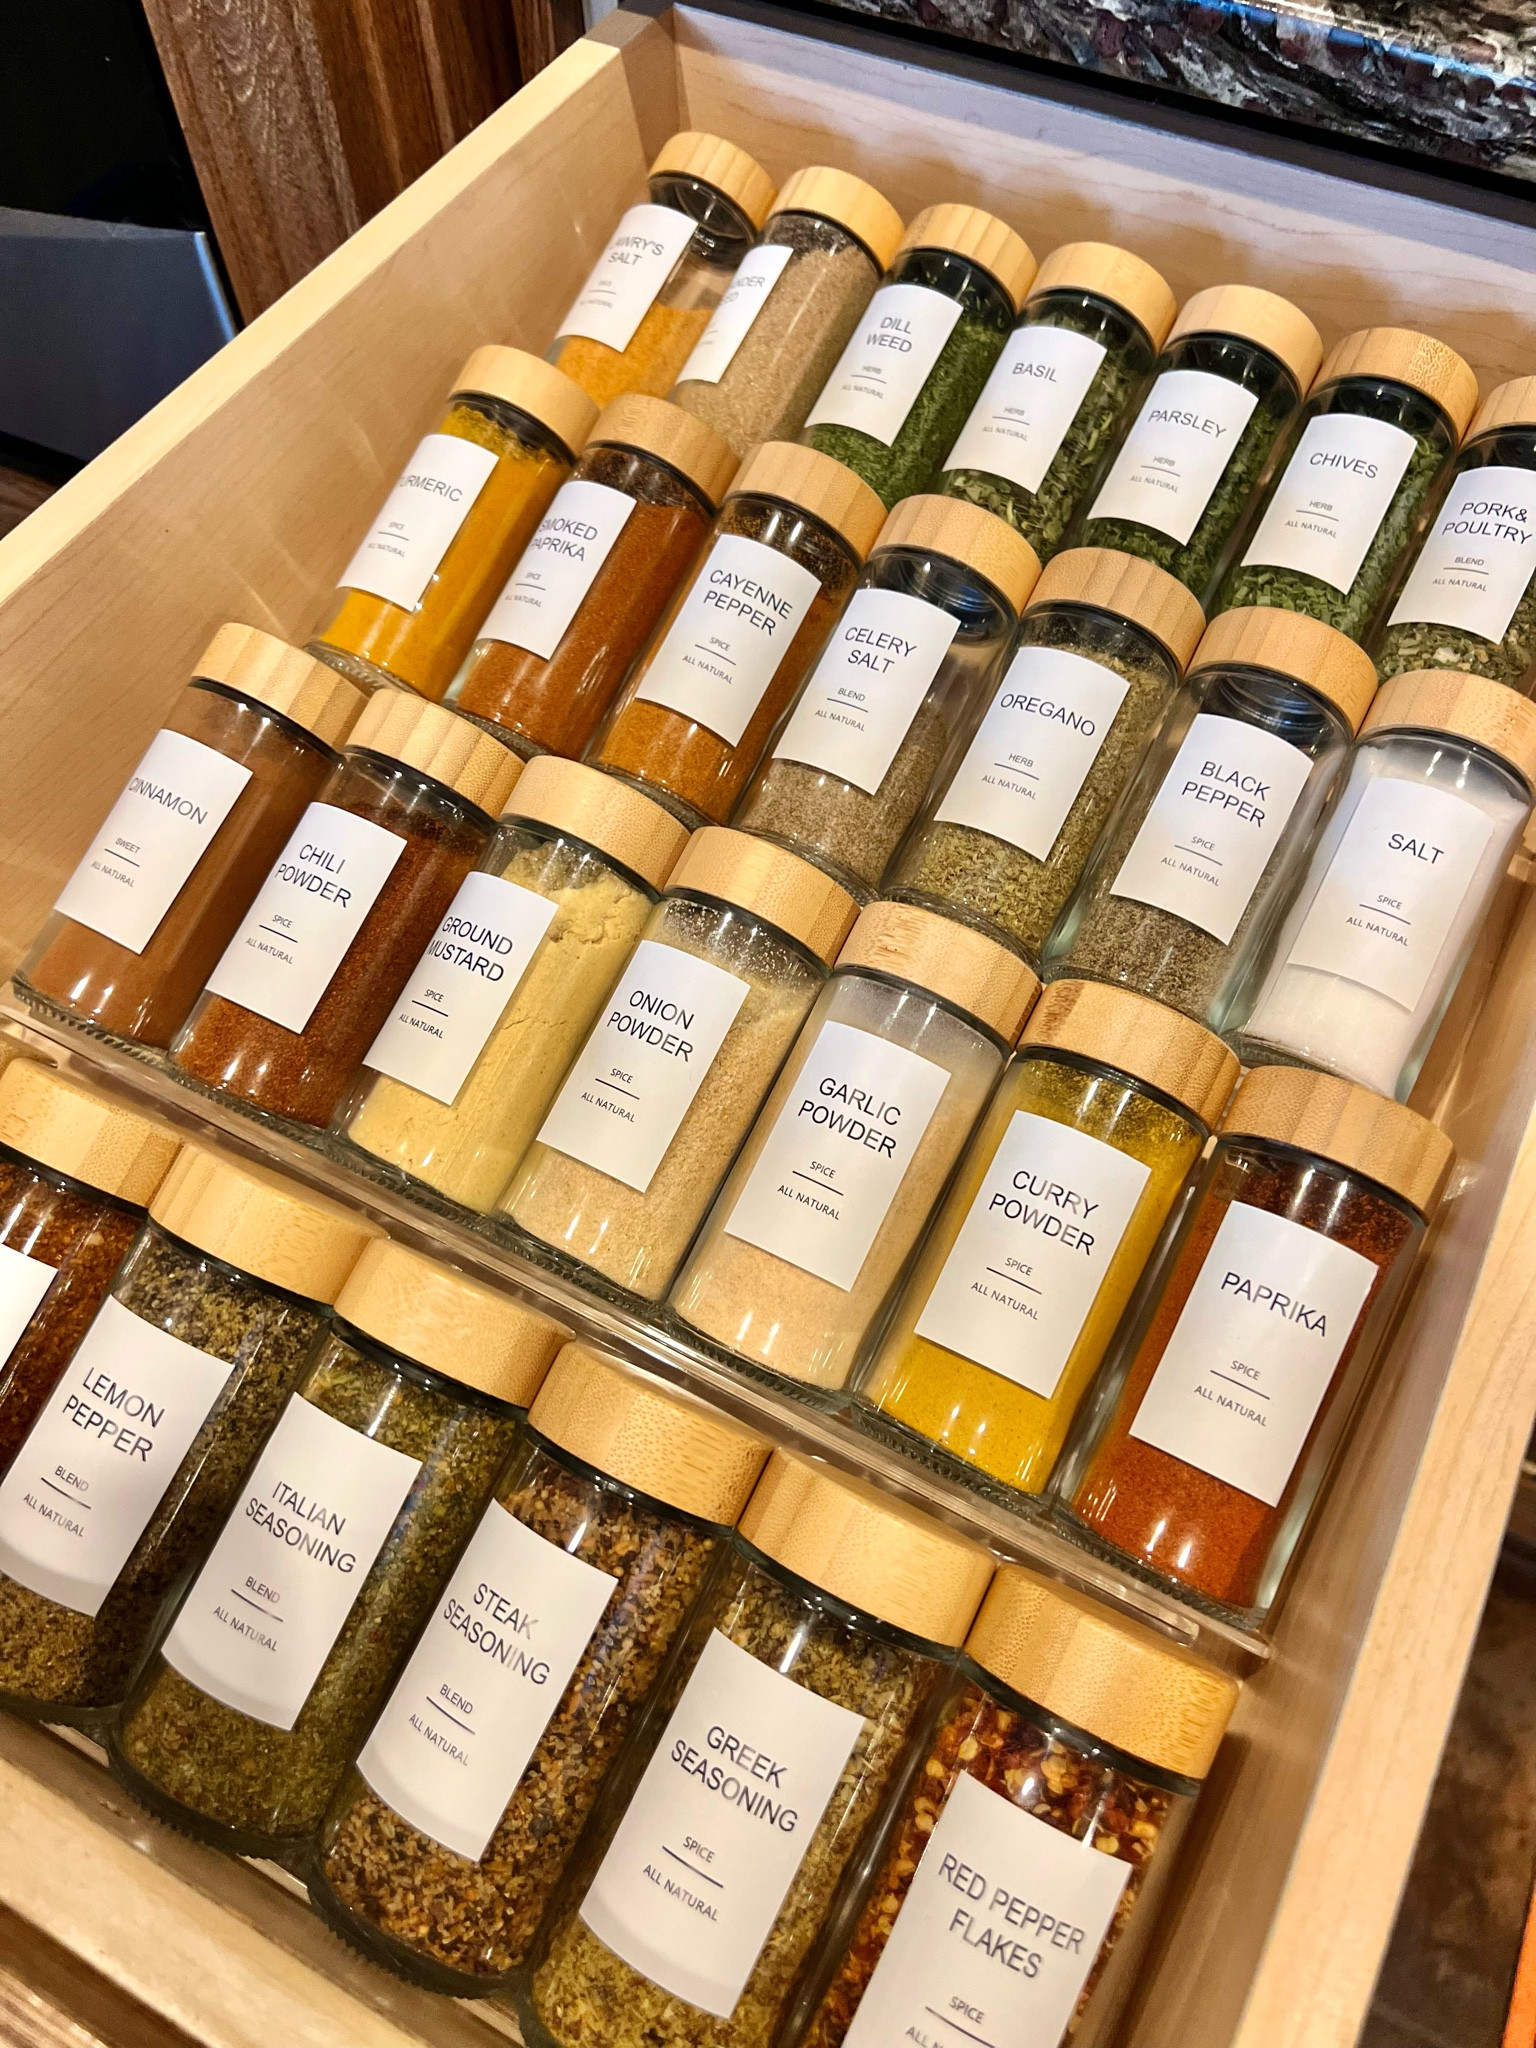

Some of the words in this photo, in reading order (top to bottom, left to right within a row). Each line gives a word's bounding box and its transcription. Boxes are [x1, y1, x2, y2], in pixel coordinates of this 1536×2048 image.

[608, 252, 642, 266] SALT
[880, 317, 912, 334] DILL
[866, 334, 912, 353] WEED
[862, 366, 882, 374] HERB
[1012, 362, 1057, 382] BASIL
[854, 386, 883, 400] NATURAL
[1004, 406, 1025, 416] HERB
[1148, 410, 1227, 438] PARSLEY
[996, 427, 1028, 442] NATURAL
[1153, 456, 1176, 467] HERB
[1310, 453, 1378, 478] CHIVES
[1144, 477, 1178, 494] NATURAL
[1310, 500, 1333, 512] HERB
[1460, 502, 1528, 524] PORK&
[388, 521, 405, 530] SPICE
[1285, 520, 1298, 528] ALL
[1301, 522, 1337, 538] NATURAL
[1442, 521, 1532, 544] POULTRY
[378, 543, 405, 558] NATURAL
[1454, 556, 1484, 566] BLEND
[526, 572, 542, 580] SPICE
[1448, 579, 1487, 592] NATURAL
[514, 595, 542, 608] NATURAL
[710, 570, 792, 620] CAYENNE
[704, 590, 776, 636] PEPPER
[709, 637, 730, 652] SPICE
[845, 627, 916, 657] CELERY
[682, 654, 696, 666] ALL
[698, 660, 732, 684] NATURAL
[848, 650, 894, 674] SALT
[838, 687, 866, 702] BLEND
[815, 709, 827, 718] ALL
[830, 712, 865, 732] NATURAL
[1000, 694, 1096, 736] OREGANO
[1008, 753, 1034, 768] HERB
[982, 775, 996, 784] ALL
[998, 779, 1036, 800] NATURAL
[1200, 761, 1270, 800] BLACK
[129, 777, 208, 824] CINNAMON
[1181, 781, 1265, 828] PEPPER
[115, 837, 140, 854] SWEET
[1191, 836, 1215, 852] SPICE
[1388, 834, 1444, 864] SALT
[299, 844, 346, 875] CHILI
[1160, 856, 1177, 868] ALL
[1179, 862, 1220, 886] NATURAL
[91, 860, 101, 870] ALL
[102, 865, 134, 888] NATURAL
[275, 864, 352, 908] POWDER
[1376, 894, 1402, 910] SPICE
[272, 914, 293, 928] SPICE
[1346, 916, 1363, 928] ALL
[1366, 922, 1408, 946] NATURAL
[442, 916, 513, 955] GROUND
[246, 938, 256, 948] ALL
[258, 942, 293, 964] NATURAL
[426, 940, 504, 982] MUSTARD
[424, 989, 444, 1002] SPICE
[629, 990, 694, 1030] ONION
[399, 1013, 408, 1024] ALL
[409, 1017, 444, 1039] NATURAL
[607, 1012, 694, 1062] POWDER
[610, 1068, 634, 1084] SPICE
[581, 1091, 594, 1104] ALL
[595, 1098, 635, 1122] NATURAL
[819, 1078, 902, 1126] GARLIC
[798, 1100, 897, 1158] POWDER
[810, 1161, 836, 1179] SPICE
[778, 1184, 793, 1198] ALL
[796, 1192, 840, 1220] NATURAL
[1012, 1170, 1099, 1220] CURRY
[988, 1193, 1095, 1256] POWDER
[1005, 1257, 1032, 1276] SPICE
[971, 1282, 988, 1296] ALL
[991, 1290, 1038, 1320] NATURAL
[1220, 1272, 1327, 1337] PAPRIKA
[1230, 1360, 1260, 1381] SPICE
[83, 1367, 165, 1428] LEMON
[1194, 1385, 1213, 1401] ALL
[1216, 1395, 1267, 1426] NATURAL
[62, 1394, 154, 1463] PEPPER
[54, 1466, 89, 1492] BLEND
[24, 1493, 39, 1509] ALL
[38, 1501, 84, 1537] NATURAL
[272, 1481, 346, 1535] ITALIAN
[246, 1498, 356, 1573] SEASONING
[245, 1576, 280, 1603] BLEND
[474, 1583, 538, 1640] STEAK
[213, 1606, 230, 1624] ALL
[230, 1618, 276, 1652] NATURAL
[444, 1599, 550, 1685] SEASONING
[440, 1684, 474, 1714] BLEND
[408, 1713, 424, 1734] ALL
[424, 1726, 468, 1766] NATURAL
[706, 1726, 788, 1788] GREEK
[671, 1740, 798, 1832] SEASONING
[683, 1836, 714, 1863] SPICE
[643, 1864, 661, 1886] ALL
[664, 1877, 718, 1922] NATURAL
[938, 1853, 986, 1900] RED
[989, 1888, 1085, 1954] PEPPER
[949, 1908, 1043, 1978] FLAKES
[949, 1996, 985, 2024] SPICE
[906, 2026, 927, 2048] ALL
